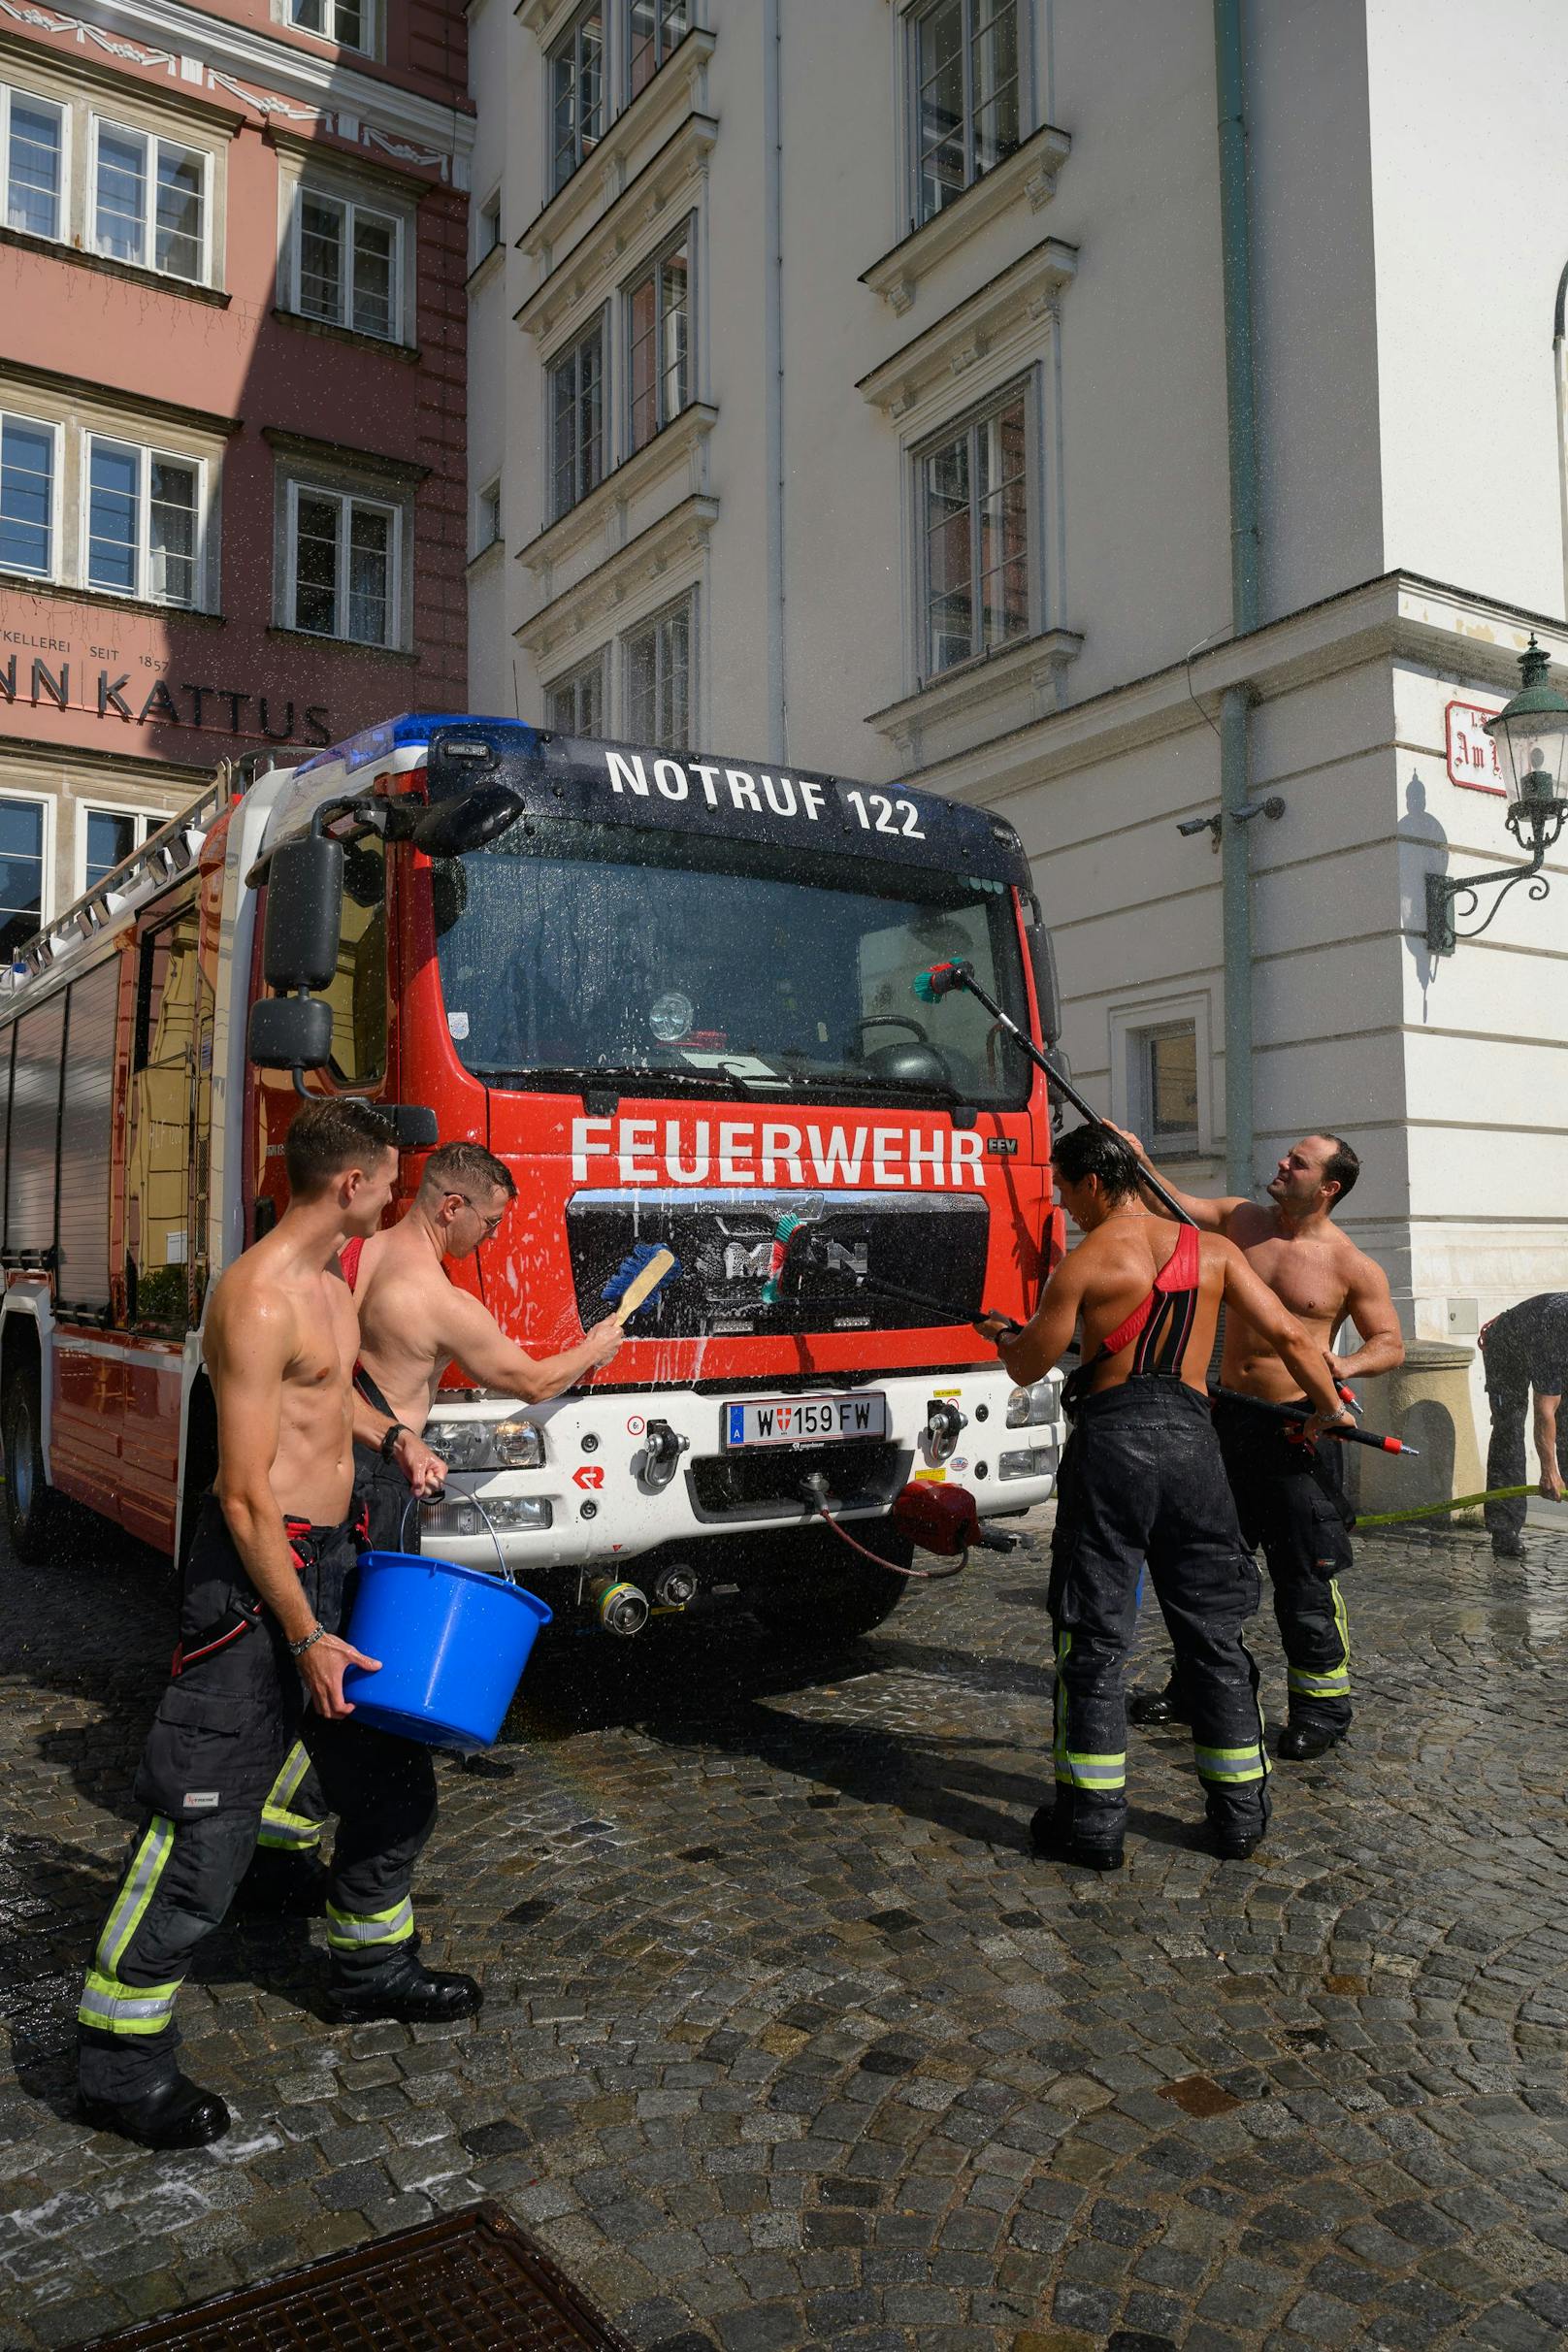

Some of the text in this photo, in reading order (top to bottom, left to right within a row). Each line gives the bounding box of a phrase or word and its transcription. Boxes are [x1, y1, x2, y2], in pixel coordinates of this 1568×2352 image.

[0, 629, 169, 672] KELLEREI SEIT 1857
[98, 670, 331, 747] KATTUS
[1454, 731, 1486, 769] Am
[604, 751, 927, 841] NOTRUF 122
[571, 1117, 987, 1187] FEUERWEHR
[988, 1138, 1017, 1153] EEV
[725, 1242, 868, 1280] MN
[733, 1428, 741, 1439] A
[758, 1402, 870, 1437] W 159 FW
